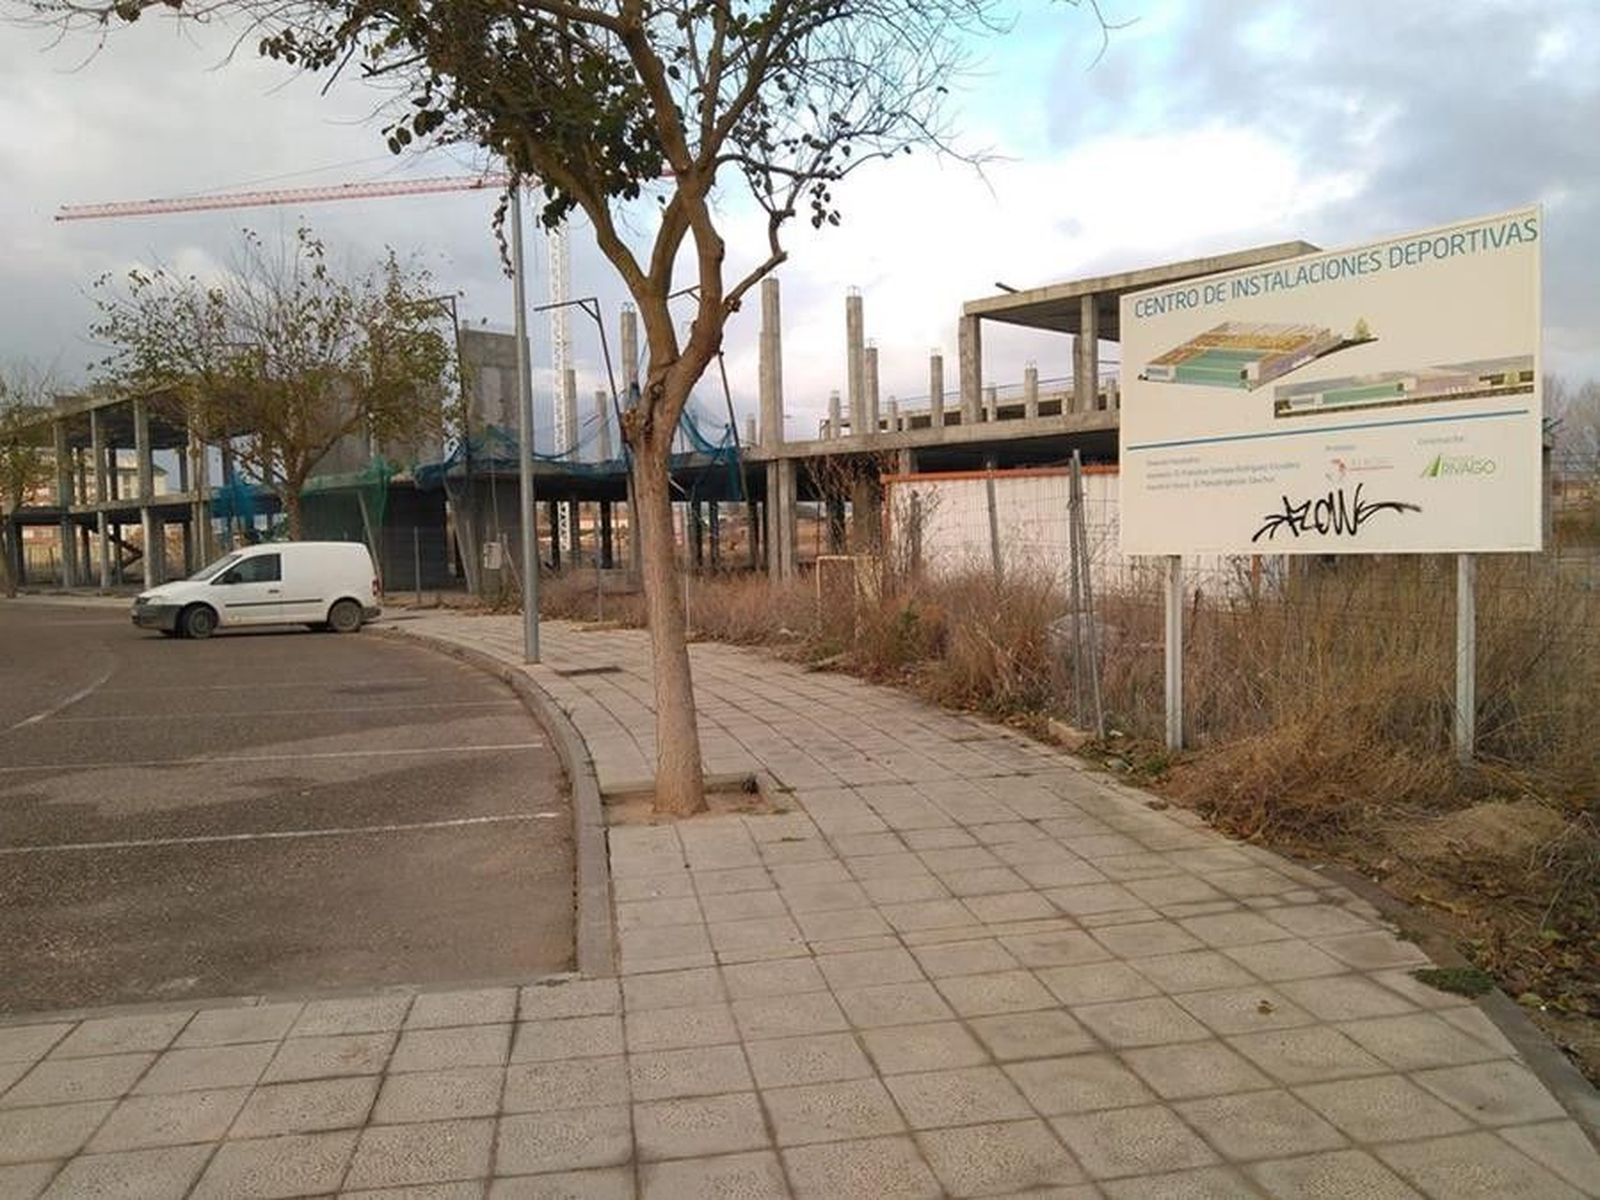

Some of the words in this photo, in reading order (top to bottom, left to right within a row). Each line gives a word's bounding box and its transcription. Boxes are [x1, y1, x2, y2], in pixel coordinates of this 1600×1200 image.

[1134, 287, 1200, 319] CENTRO
[1203, 281, 1227, 306] DE
[1231, 249, 1383, 299] INSTALACIONES
[1388, 217, 1539, 270] DEPORTIVAS
